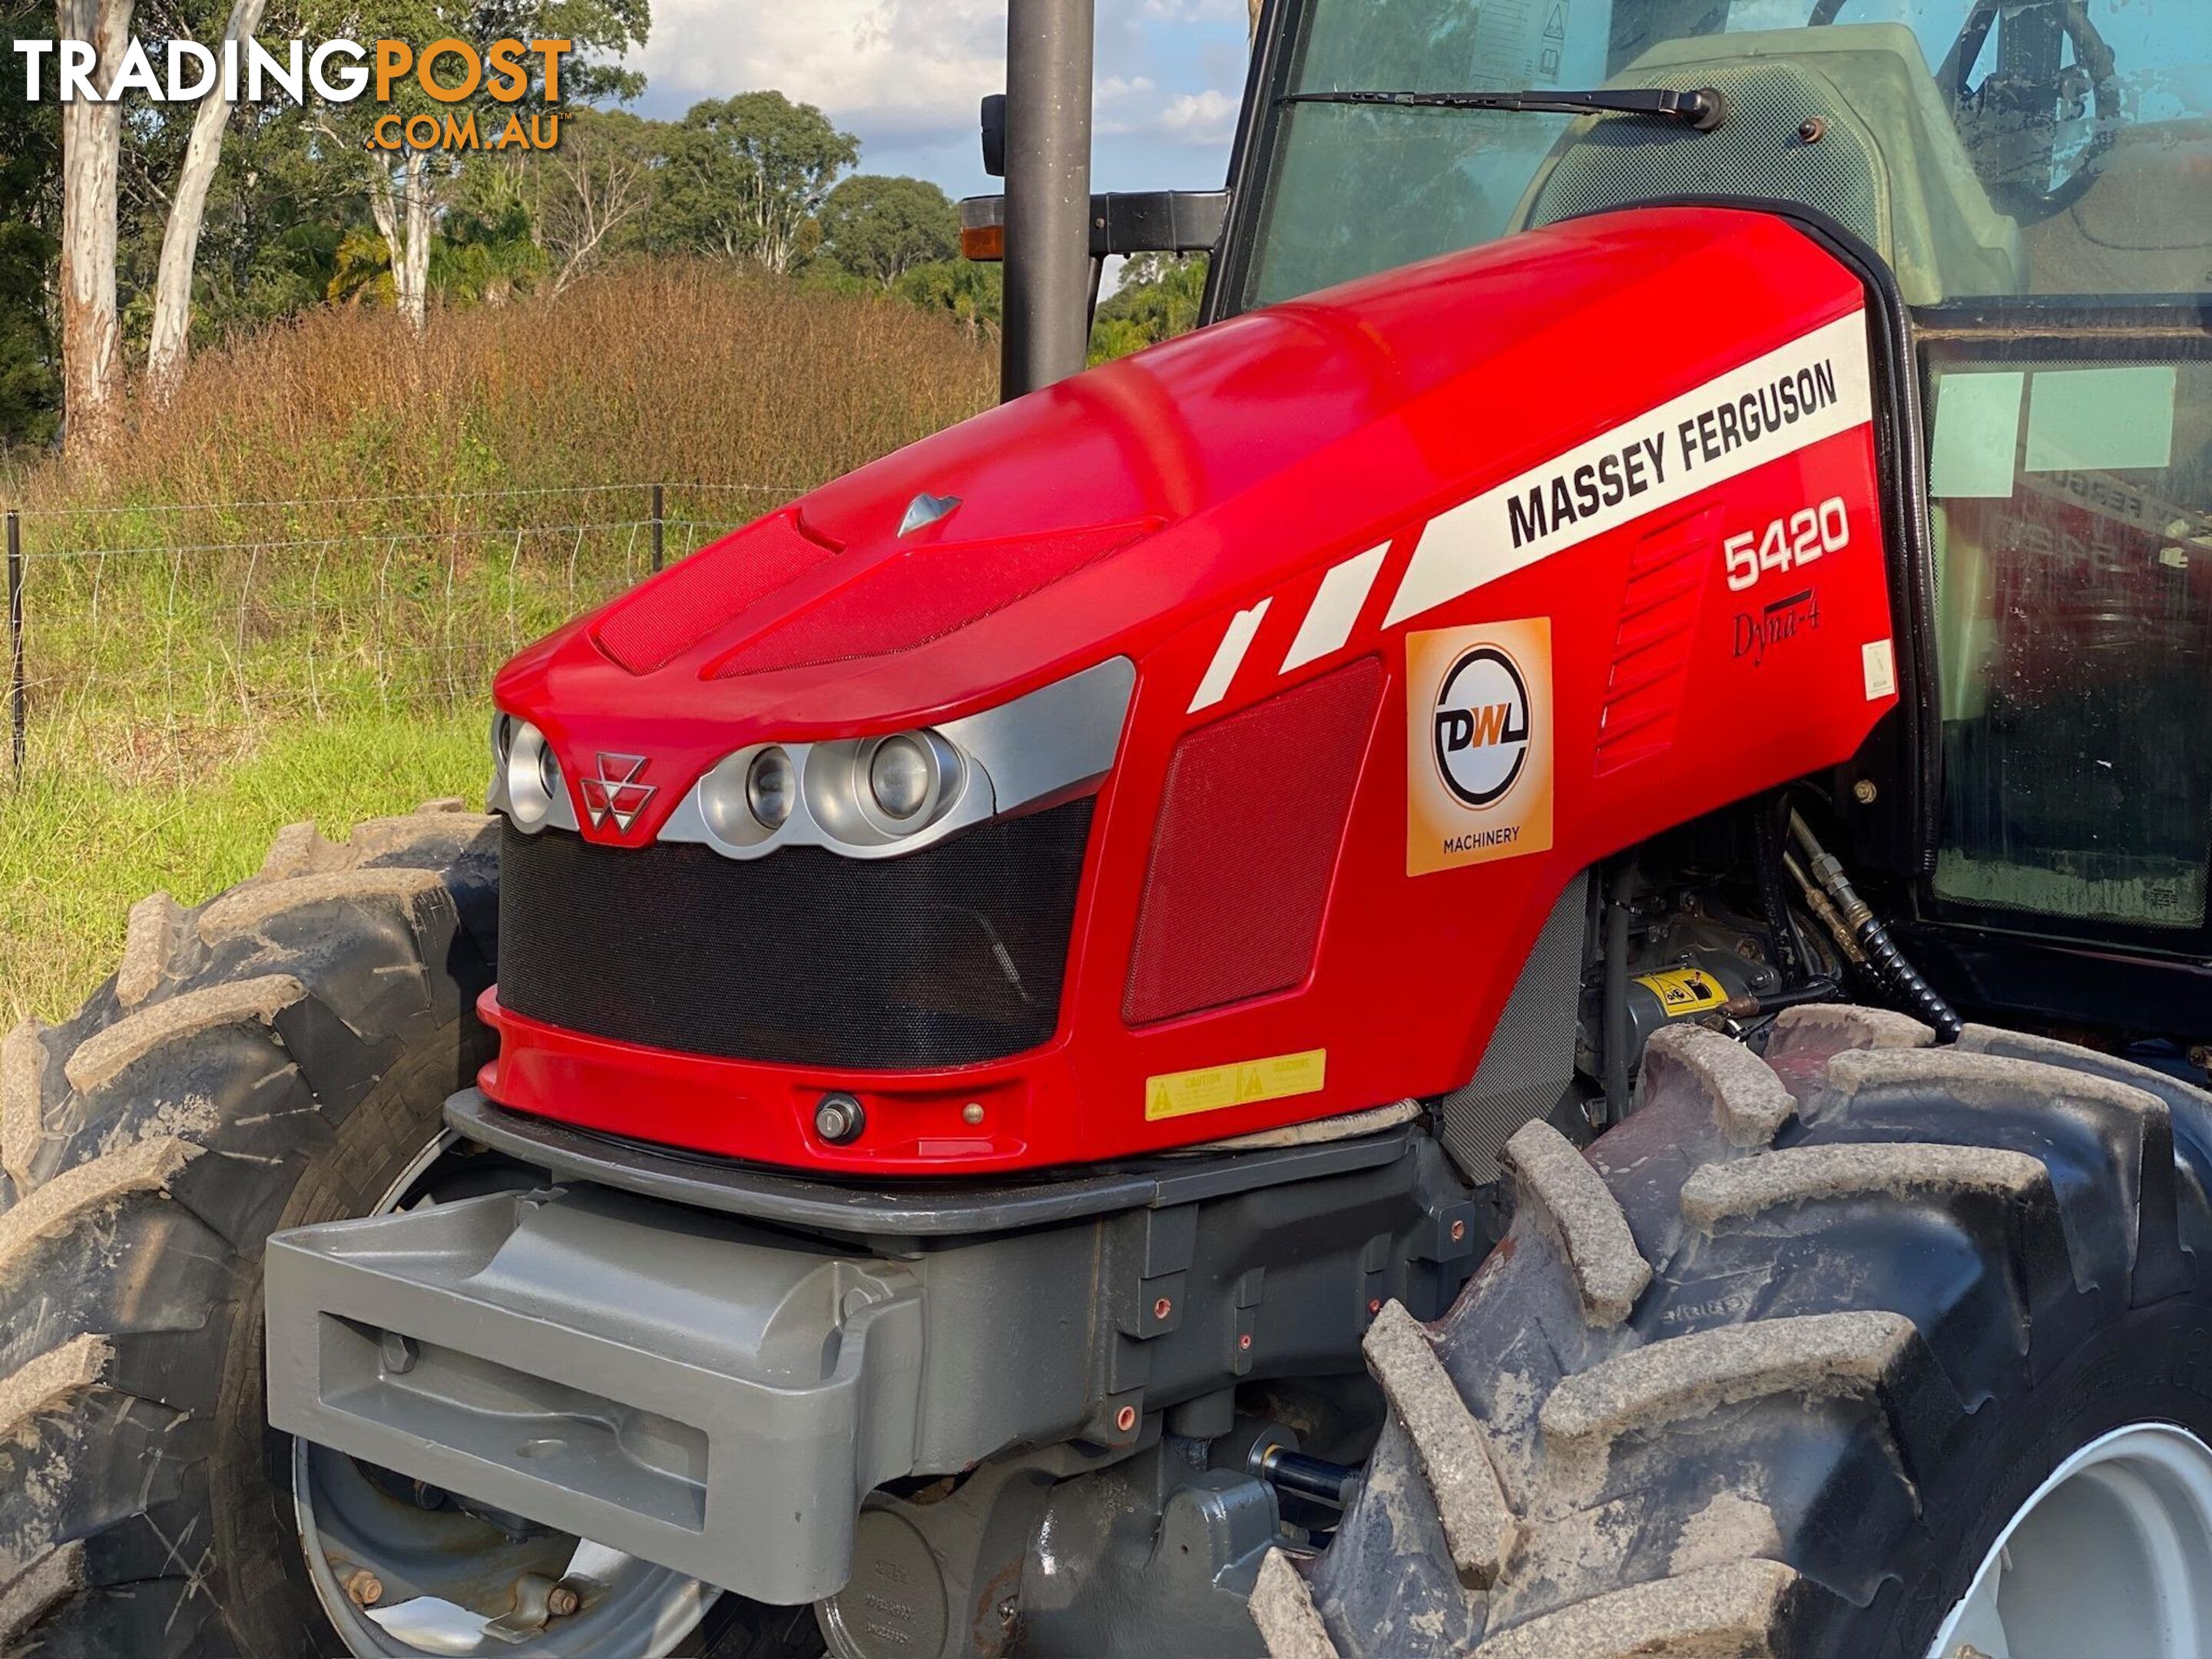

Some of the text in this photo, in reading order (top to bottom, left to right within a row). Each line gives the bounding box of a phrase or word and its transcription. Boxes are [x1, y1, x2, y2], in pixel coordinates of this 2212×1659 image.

[1507, 359, 1838, 549] MASSEY FERGUSON
[1724, 495, 1849, 591] 5420
[1733, 588, 1820, 667] Dyna-4
[1435, 703, 1528, 752] DWL
[1443, 826, 1520, 854] MACHINERY
[1184, 1072, 1222, 1089] CAUTION
